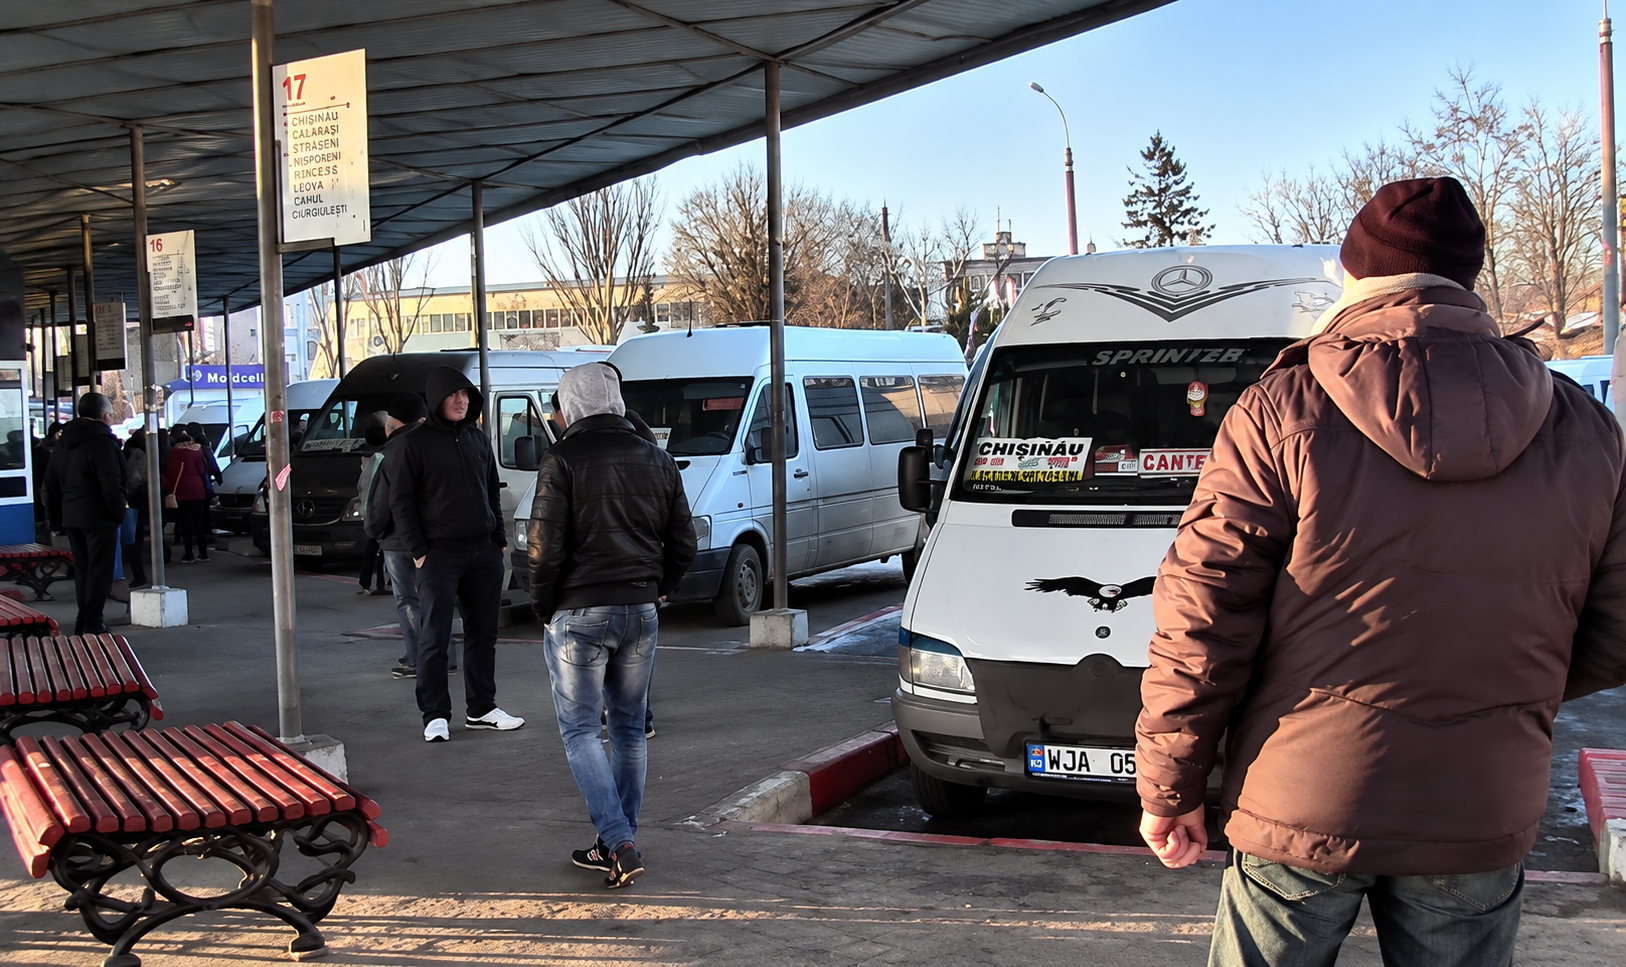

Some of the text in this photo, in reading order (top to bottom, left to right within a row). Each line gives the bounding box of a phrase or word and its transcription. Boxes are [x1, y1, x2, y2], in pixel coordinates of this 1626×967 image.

[282, 73, 307, 101] 17
[294, 151, 342, 167] NISPORENI
[293, 180, 324, 193] LEOVA
[294, 193, 324, 206] CAHUL
[149, 238, 163, 252] 16
[207, 372, 264, 384] Modcell
[1047, 748, 1137, 775] WJA 05
